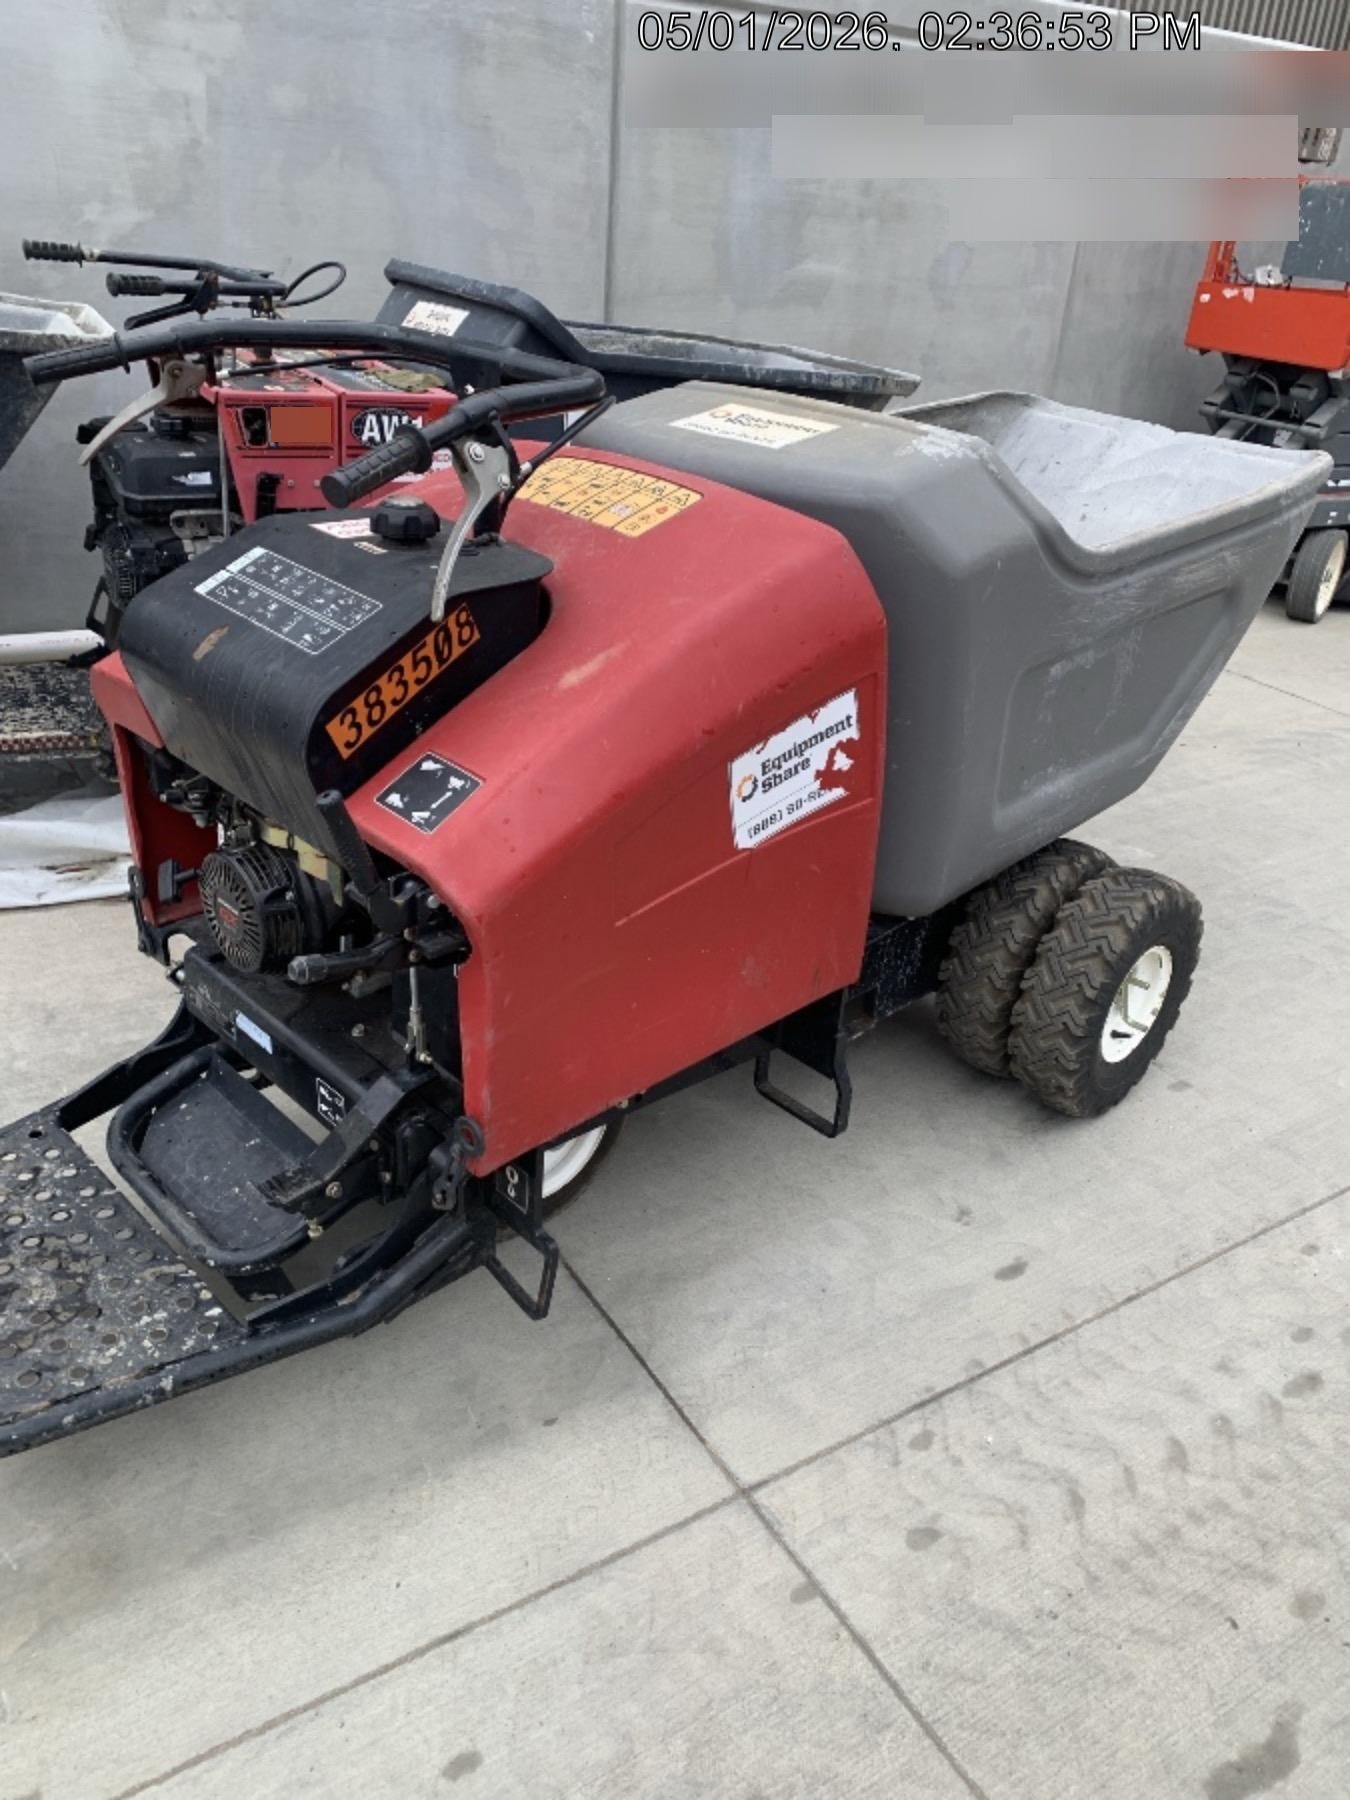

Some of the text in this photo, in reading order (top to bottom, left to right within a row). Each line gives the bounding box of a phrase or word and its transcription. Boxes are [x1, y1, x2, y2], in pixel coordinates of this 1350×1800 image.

[339, 607, 475, 750] 383508
[761, 714, 853, 776] Equipment
[761, 757, 811, 794] Share
